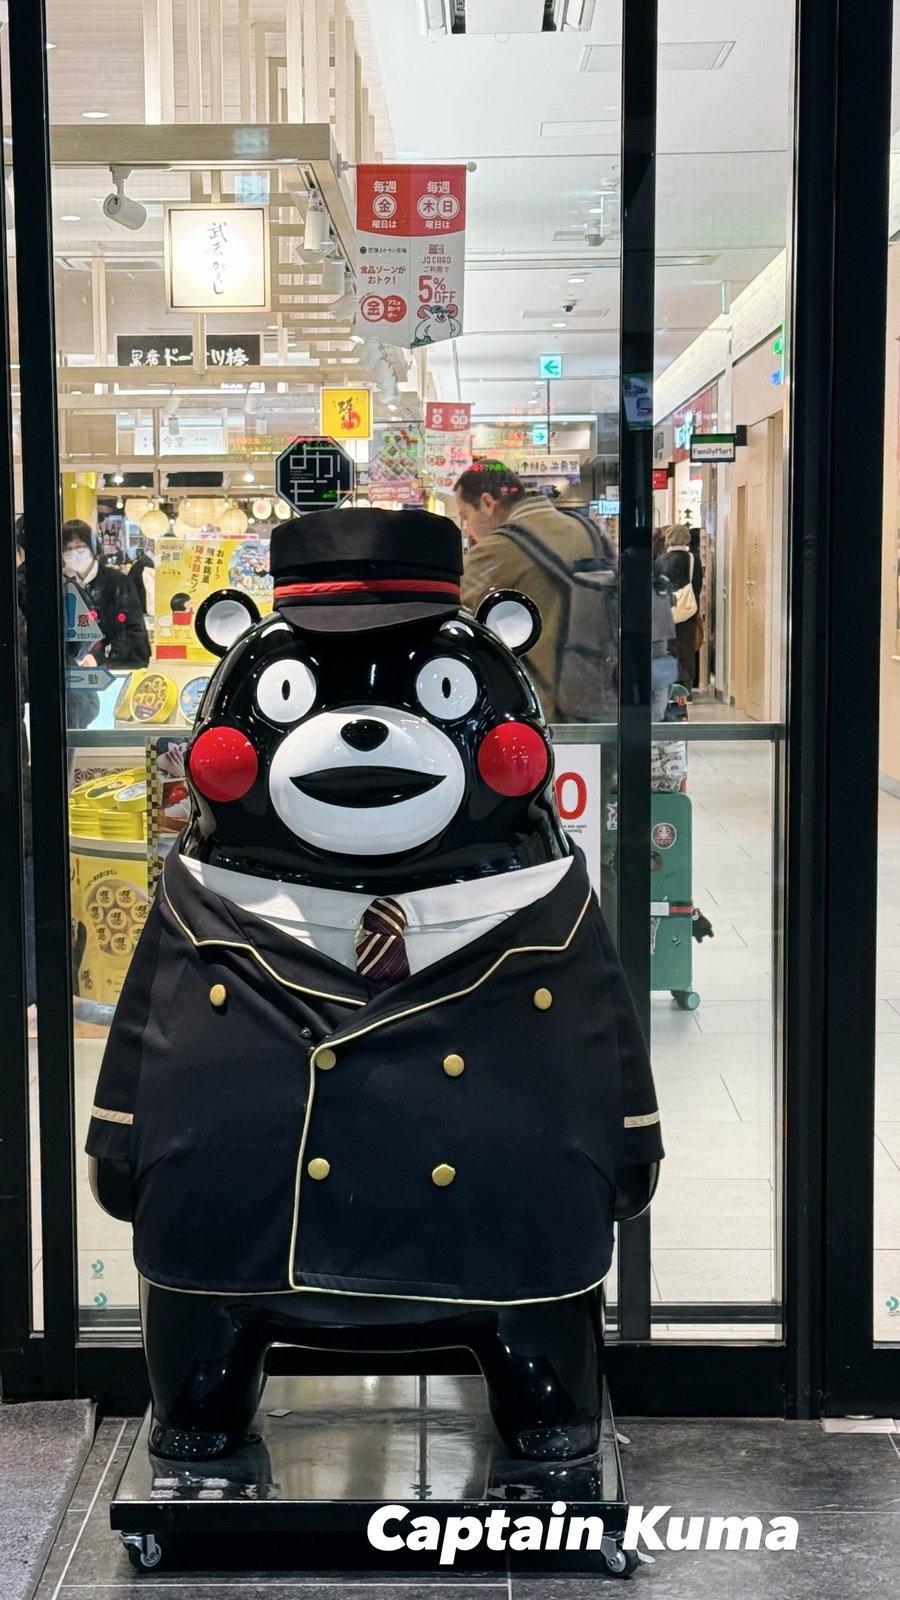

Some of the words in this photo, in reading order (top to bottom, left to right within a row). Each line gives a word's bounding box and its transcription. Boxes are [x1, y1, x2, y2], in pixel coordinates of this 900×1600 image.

[372, 180, 397, 194] 毎週
[426, 181, 450, 194] 毎週
[377, 199, 391, 213] 金
[371, 220, 397, 229] 曜日は
[425, 220, 450, 229] 曜日は
[423, 265, 450, 273] ご利用で
[367, 301, 381, 315] 金
[693, 447, 732, 456] FamilyMart
